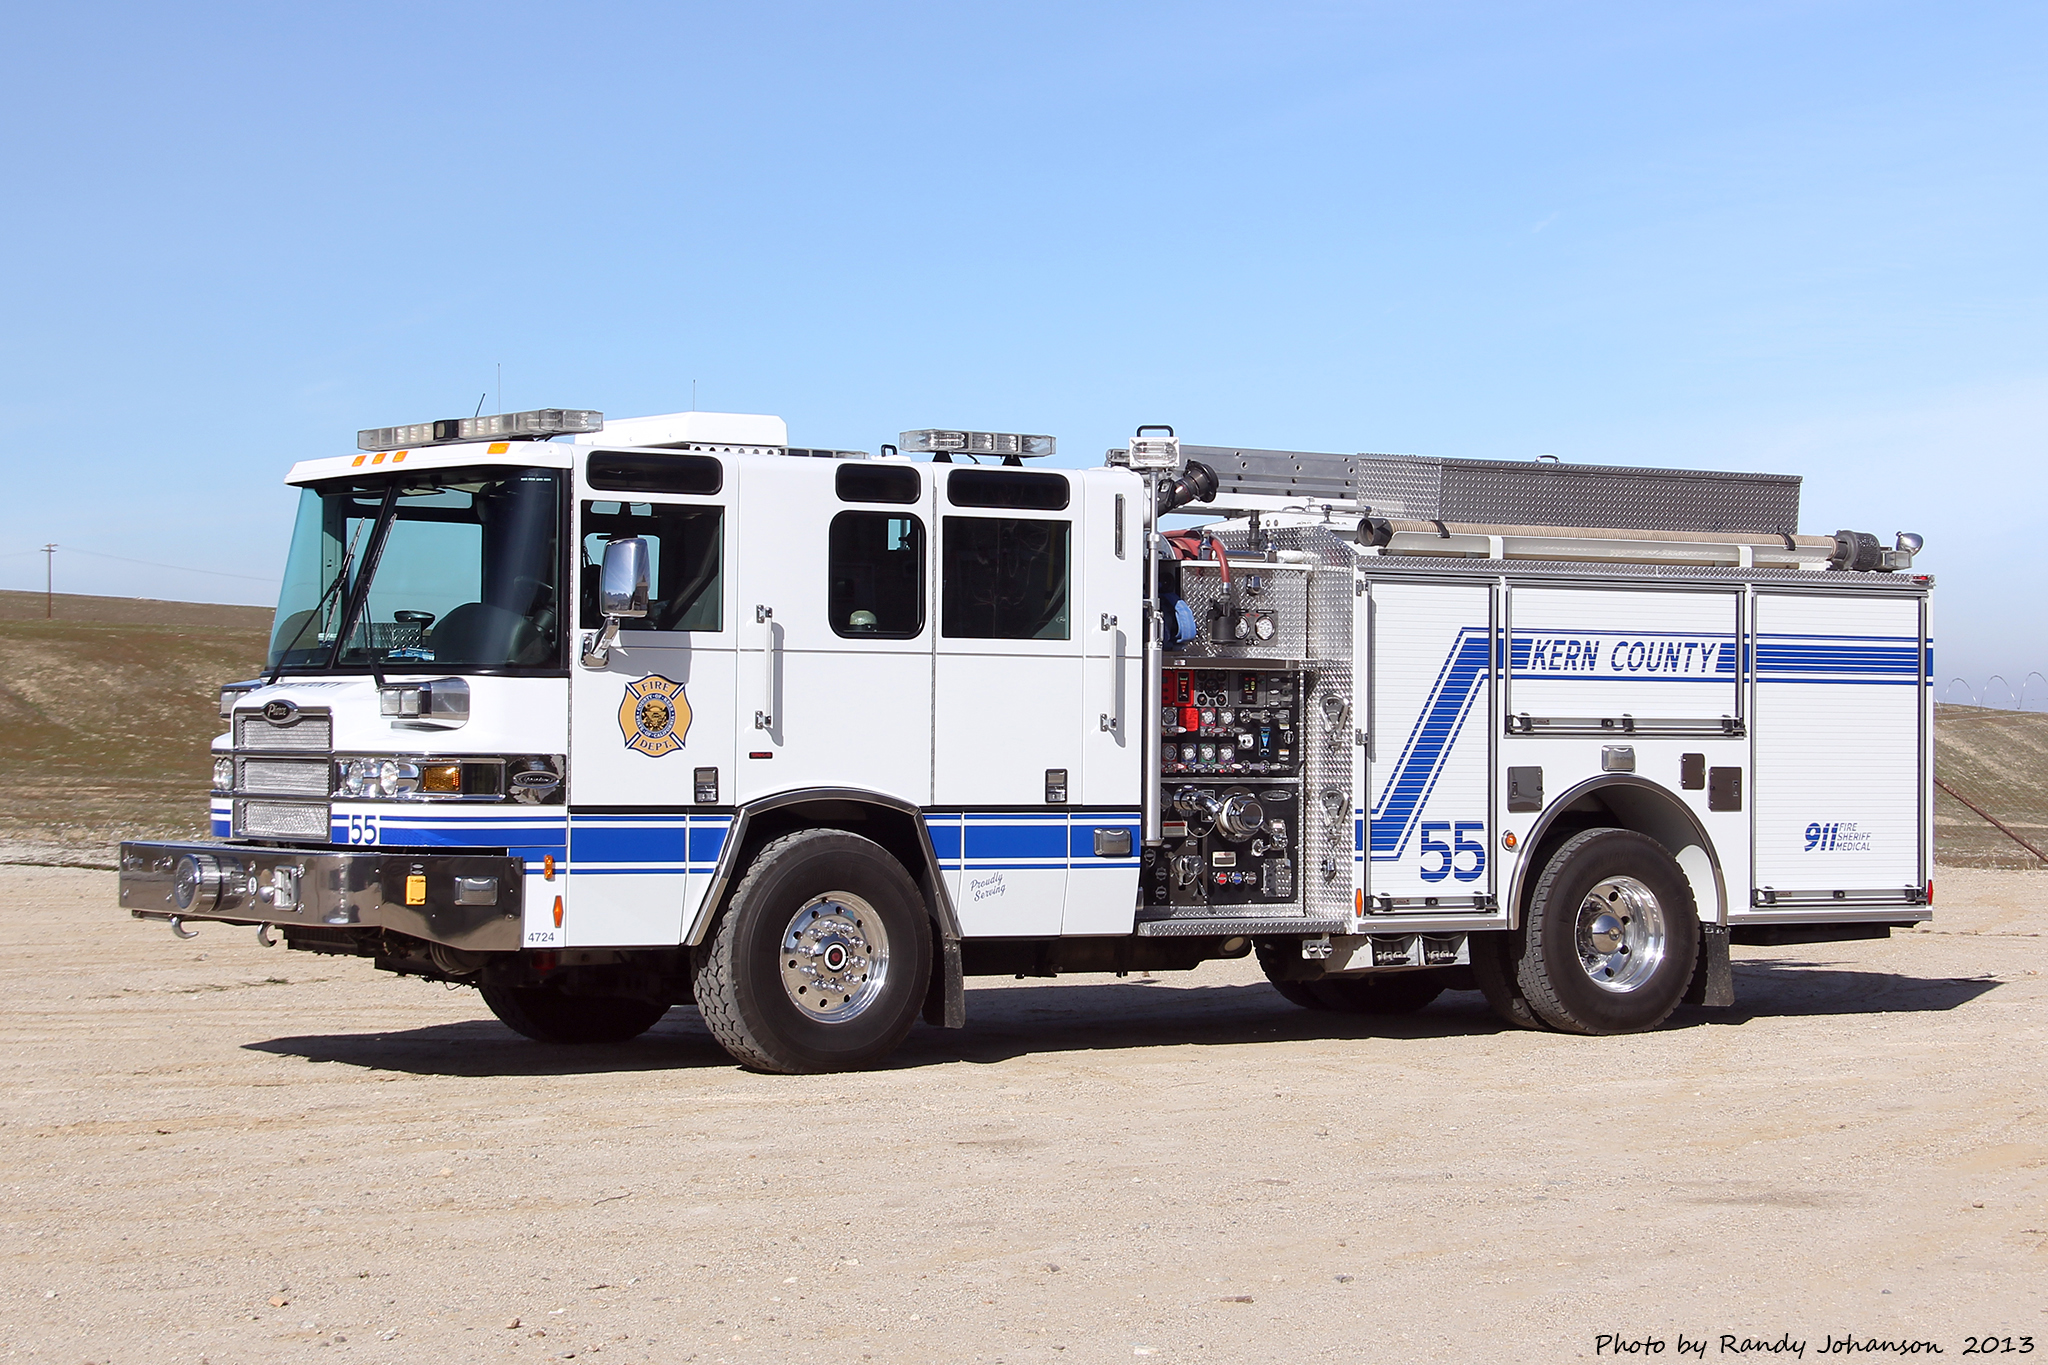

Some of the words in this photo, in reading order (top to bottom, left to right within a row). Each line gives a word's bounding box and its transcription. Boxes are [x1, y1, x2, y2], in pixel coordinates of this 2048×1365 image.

[1531, 639, 1600, 671] KERN
[1611, 641, 1717, 673] COUNTY
[641, 681, 671, 692] FIRE
[639, 739, 672, 751] DEPT.
[351, 814, 377, 845] 55
[1838, 822, 1858, 832] FIRE
[1804, 822, 1839, 852] 911
[1837, 832, 1872, 841] SHERIFF
[1420, 821, 1486, 883] 55
[1836, 842, 1871, 851] MEDICAL
[970, 871, 1003, 892] Proudly
[974, 884, 1006, 902] Serving
[528, 932, 555, 942] 4724
